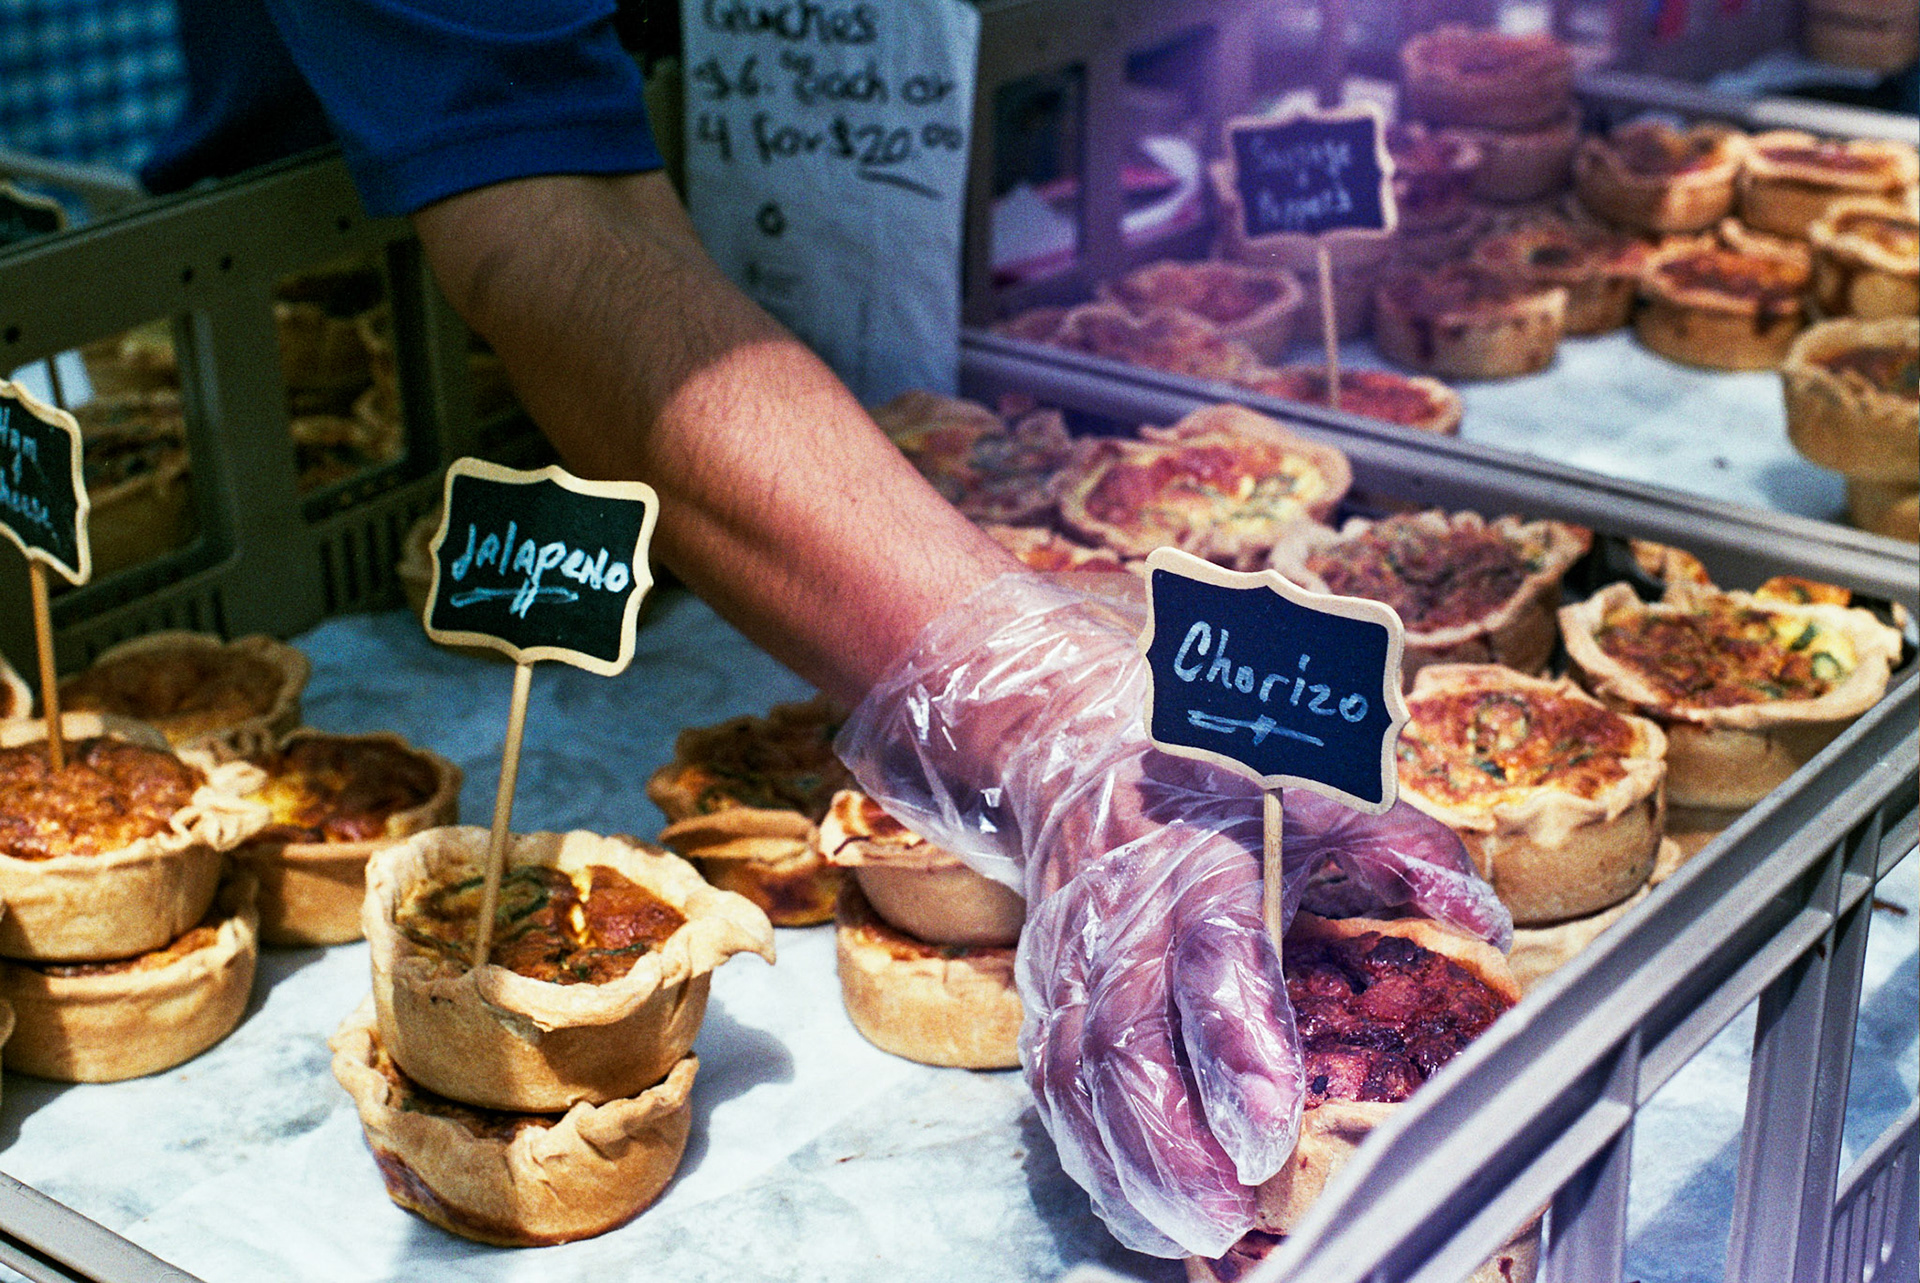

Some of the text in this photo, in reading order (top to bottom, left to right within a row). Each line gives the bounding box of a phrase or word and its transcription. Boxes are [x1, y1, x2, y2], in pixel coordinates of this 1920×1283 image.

[902, 73, 957, 105] or
[697, 112, 733, 165] 4
[752, 110, 823, 165] for
[1174, 620, 1369, 723] Chorizo
